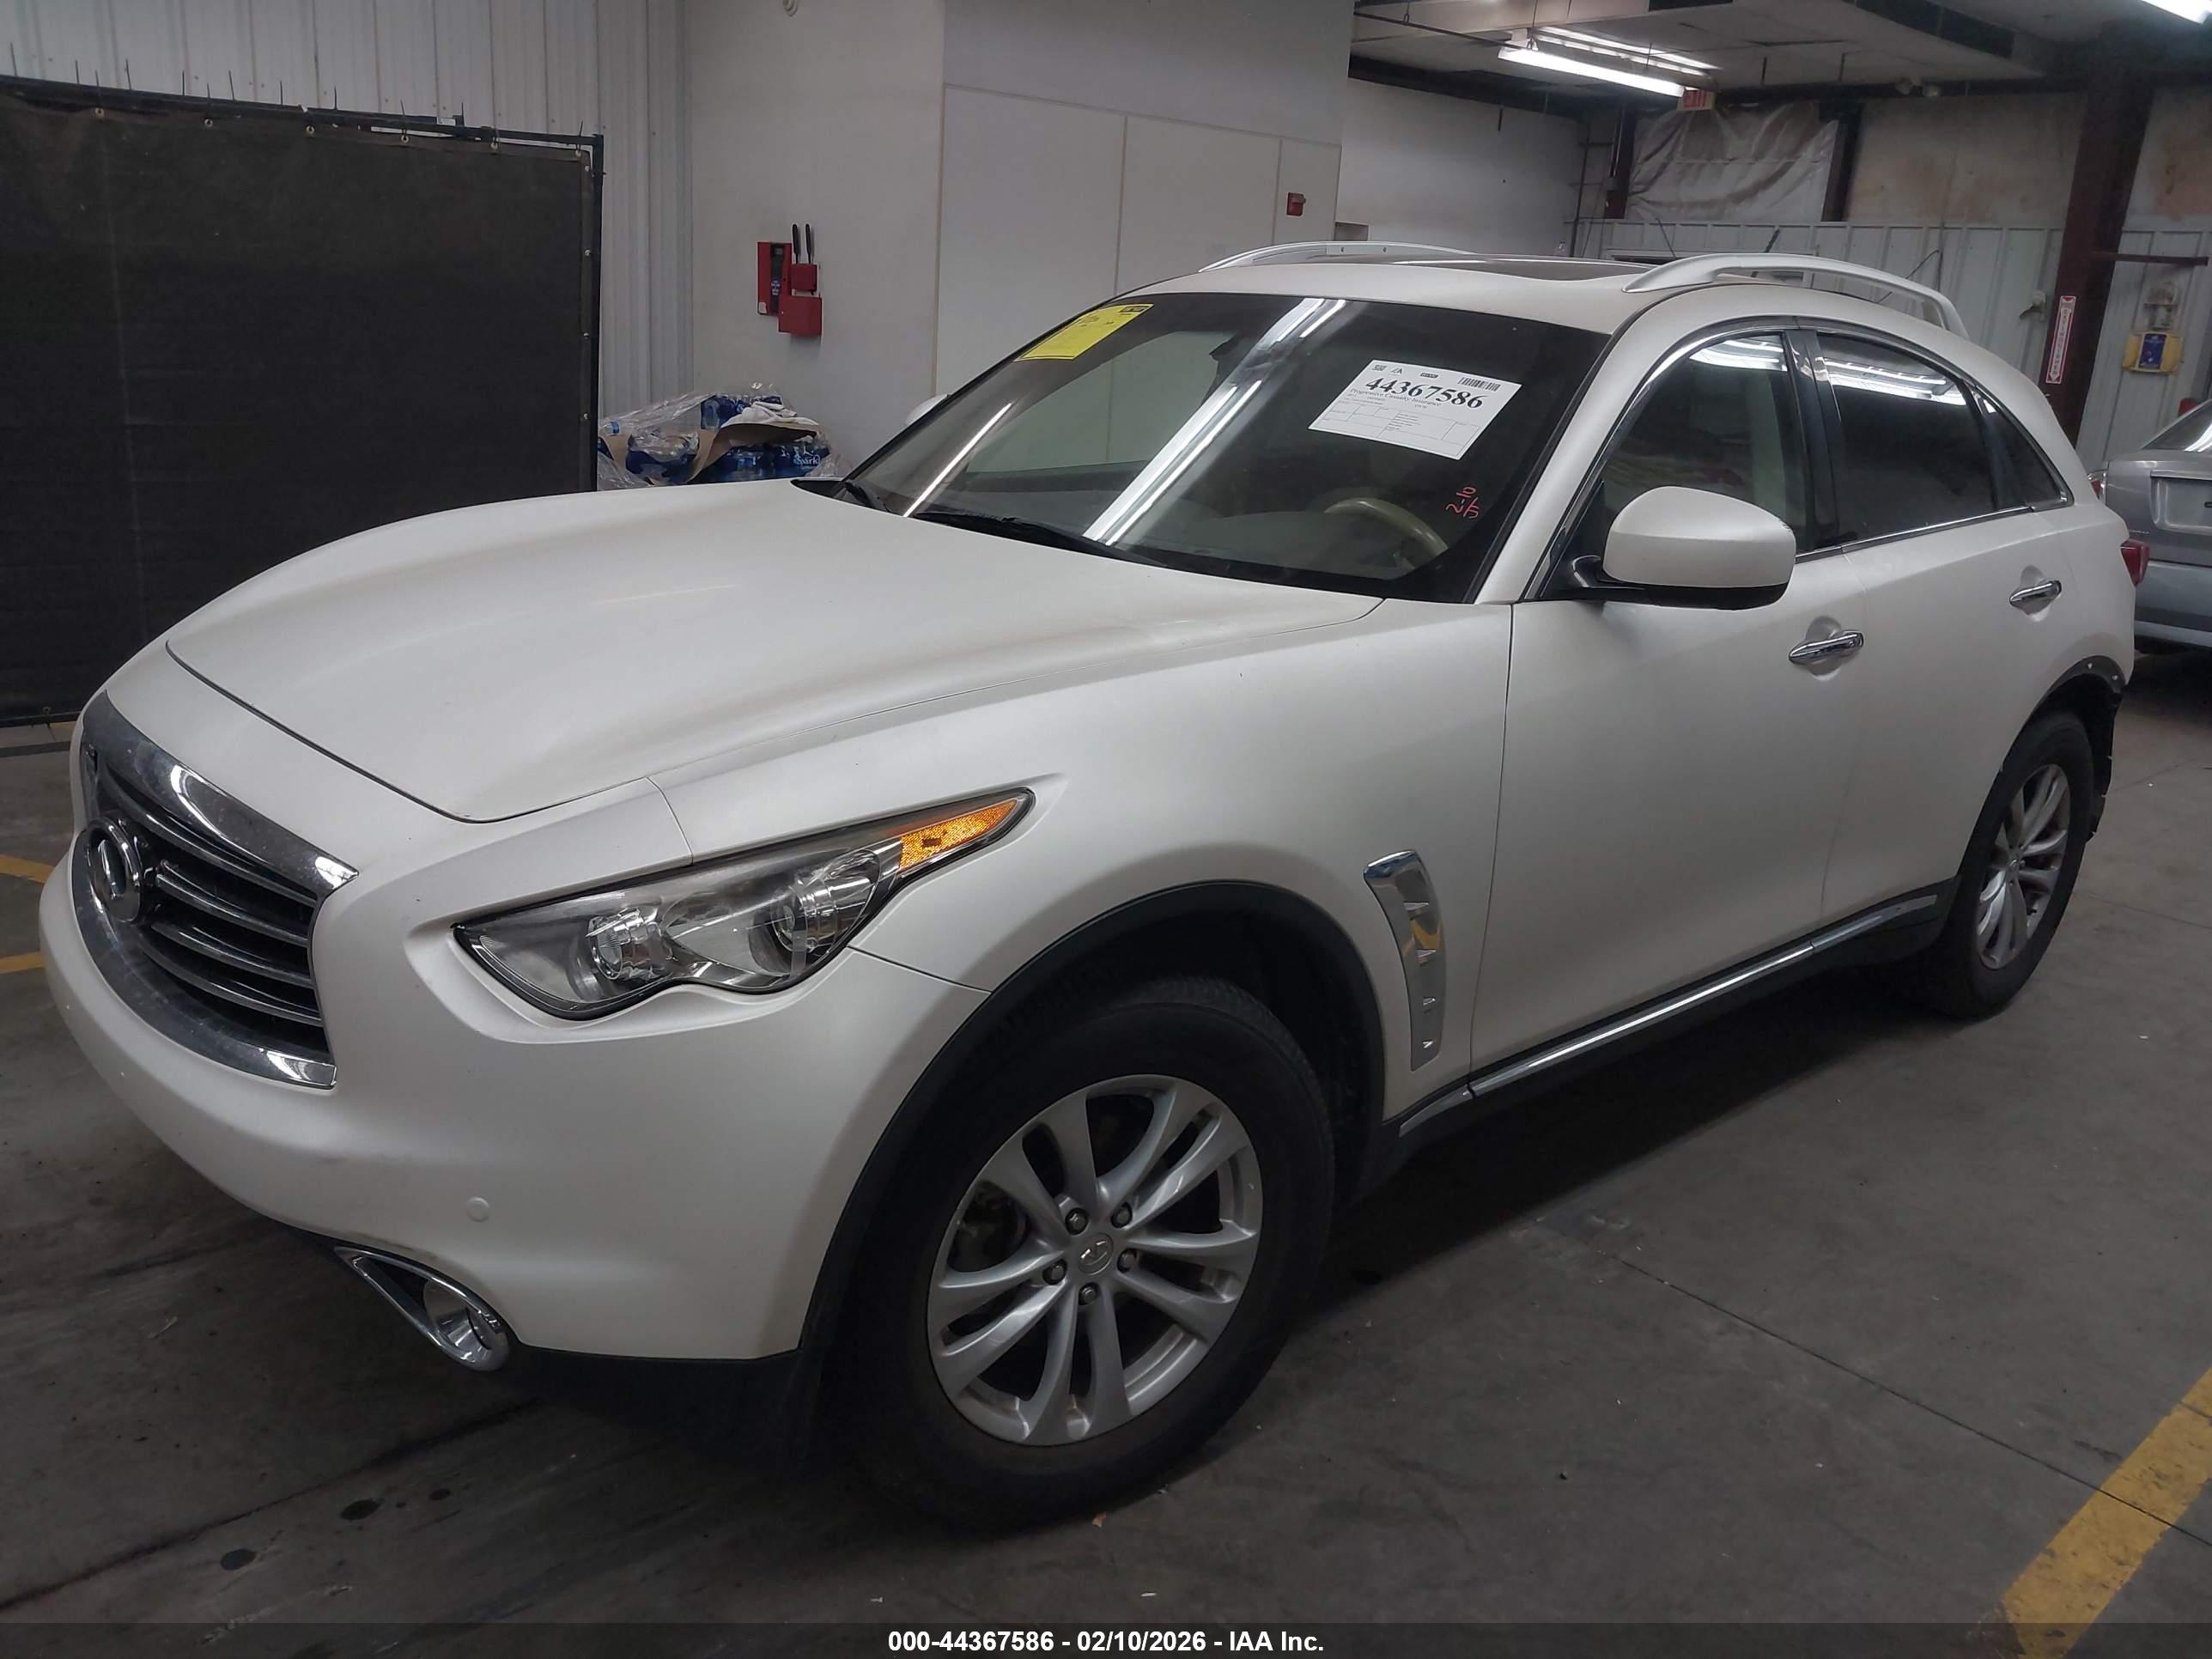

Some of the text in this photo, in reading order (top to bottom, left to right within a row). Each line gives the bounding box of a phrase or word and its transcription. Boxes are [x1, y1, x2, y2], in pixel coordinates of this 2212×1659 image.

[1350, 387, 1384, 398] Progressive
[1385, 392, 1411, 402] Casualty
[1412, 397, 1443, 407] Insurance
[1365, 377, 1490, 409] 44367586
